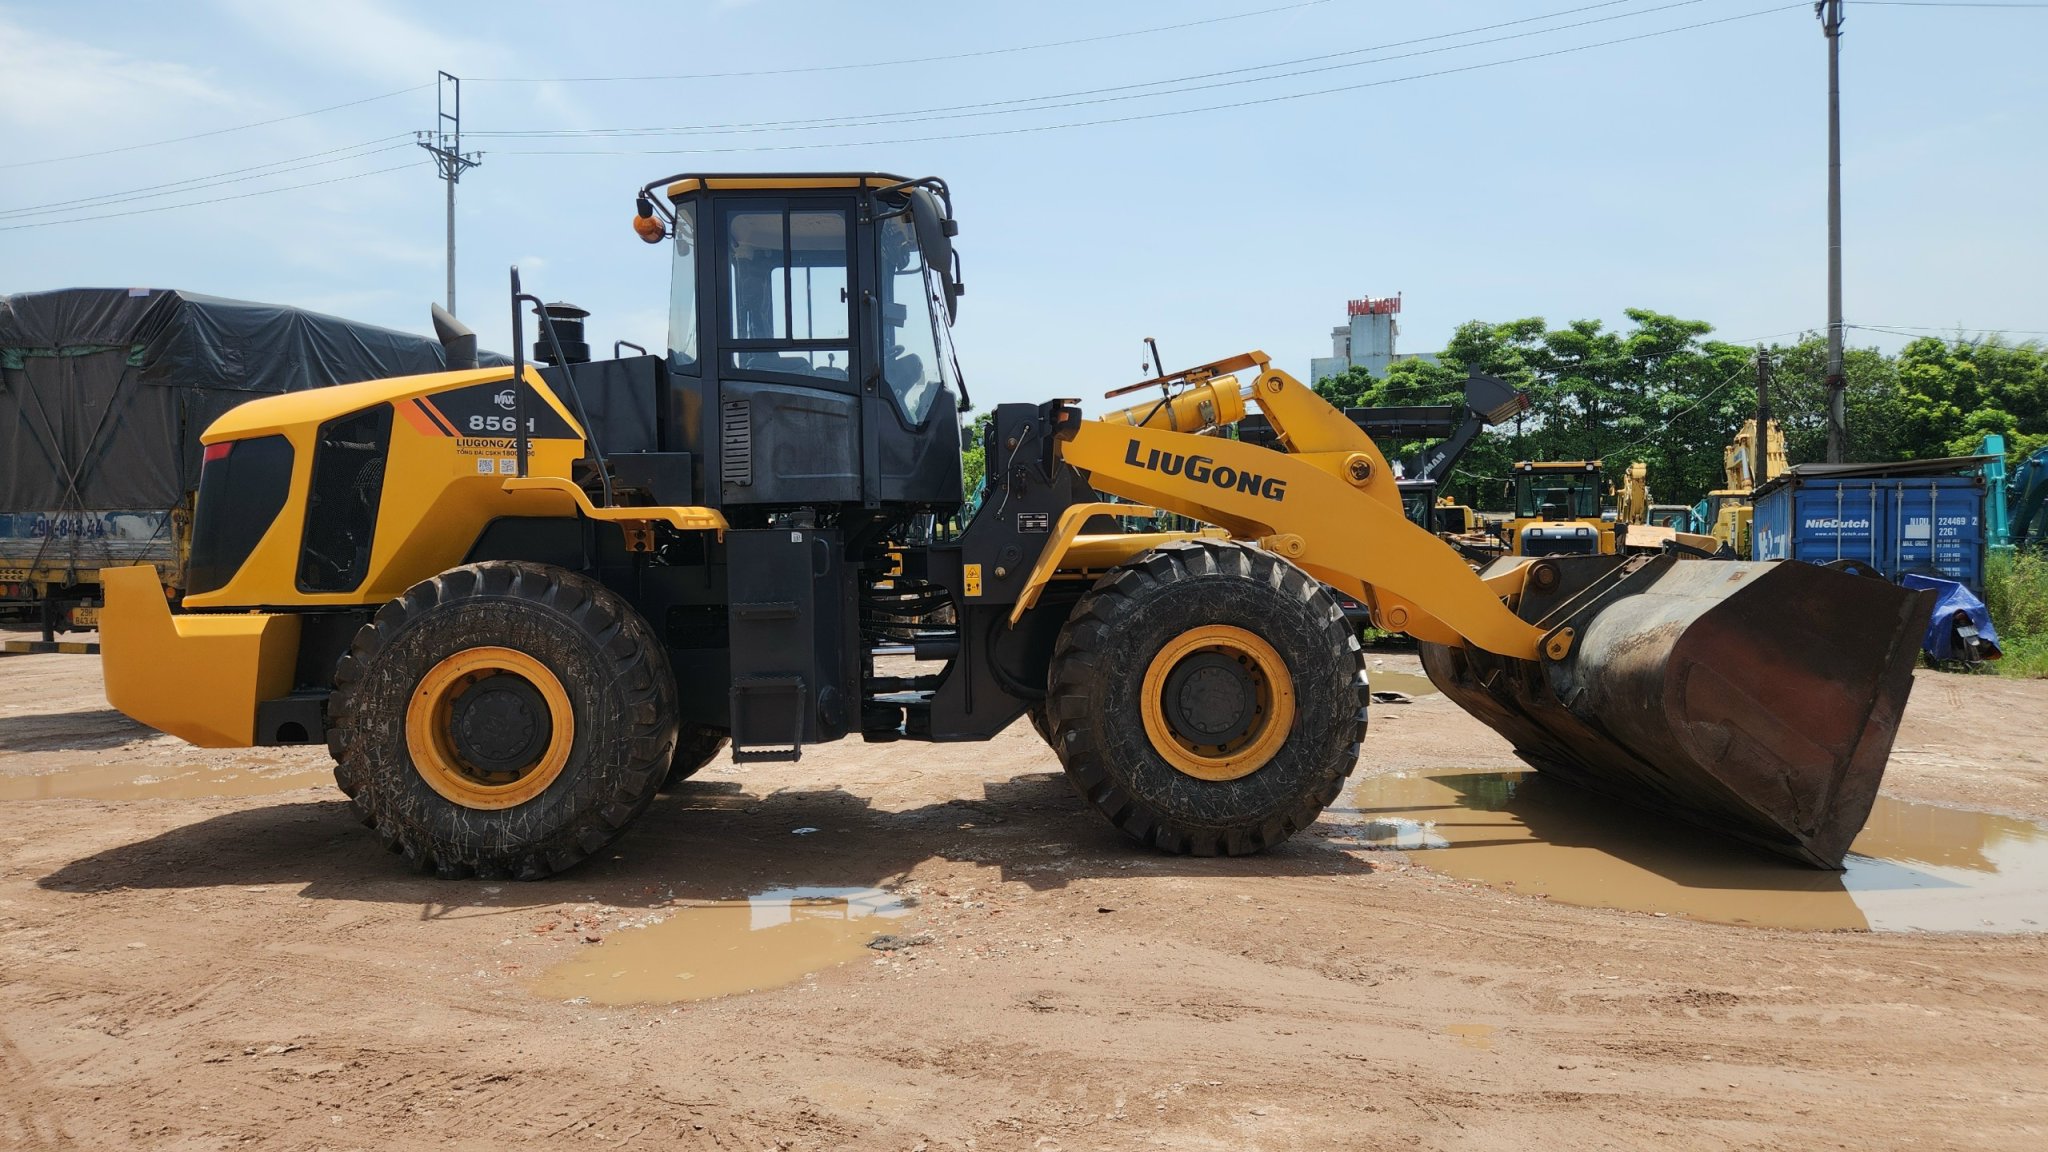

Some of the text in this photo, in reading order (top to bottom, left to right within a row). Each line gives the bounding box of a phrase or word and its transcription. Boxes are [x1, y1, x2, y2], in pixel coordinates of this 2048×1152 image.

[494, 394, 515, 405] MAX
[469, 415, 535, 432] 856H
[1805, 519, 1869, 529] NileDutch
[1938, 517, 1966, 526] 224469
[1938, 528, 1957, 536] 22G1
[80, 608, 93, 616] 29H
[75, 616, 98, 625] 843.44
